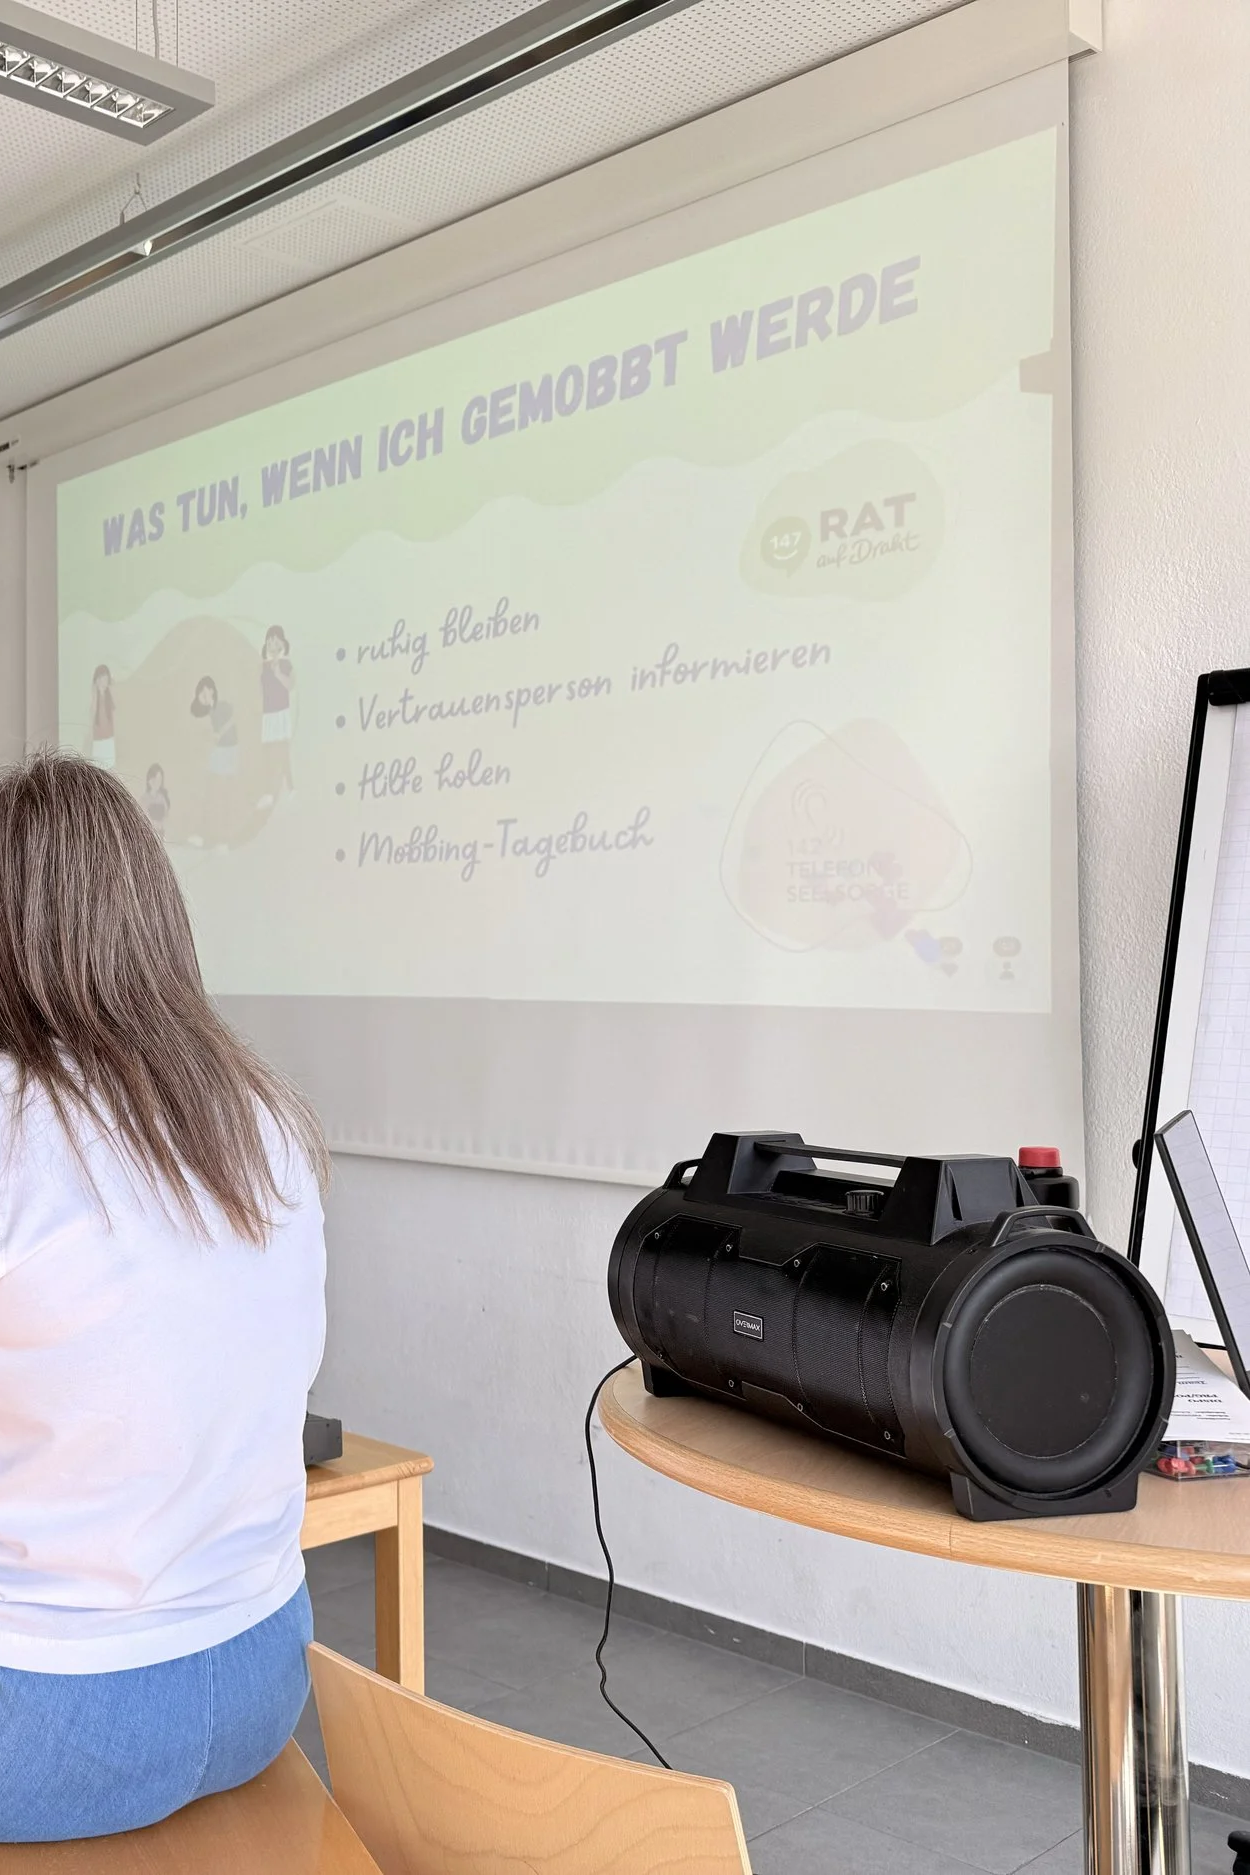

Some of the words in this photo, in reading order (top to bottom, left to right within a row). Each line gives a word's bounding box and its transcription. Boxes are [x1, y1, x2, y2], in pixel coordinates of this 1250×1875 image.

[103, 506, 165, 557] WAS
[176, 475, 248, 533] TUN,
[261, 434, 363, 509] WENN
[377, 406, 445, 473] ICH
[460, 328, 689, 446] GEMOBBT
[709, 254, 922, 375] WERDE
[769, 531, 802, 550] 147
[819, 491, 918, 544] RAT
[815, 540, 848, 569] auf
[356, 618, 430, 675] ruhig
[439, 596, 541, 649] bleiben
[357, 676, 613, 732] Vertrauensperson
[630, 641, 833, 693] informieren
[358, 755, 424, 801] Hilfe
[434, 748, 512, 792] holen
[357, 805, 655, 882] Mobbing-Tagebuch
[785, 858, 883, 879] TELEFON
[735, 1318, 761, 1332] OVERMAX
